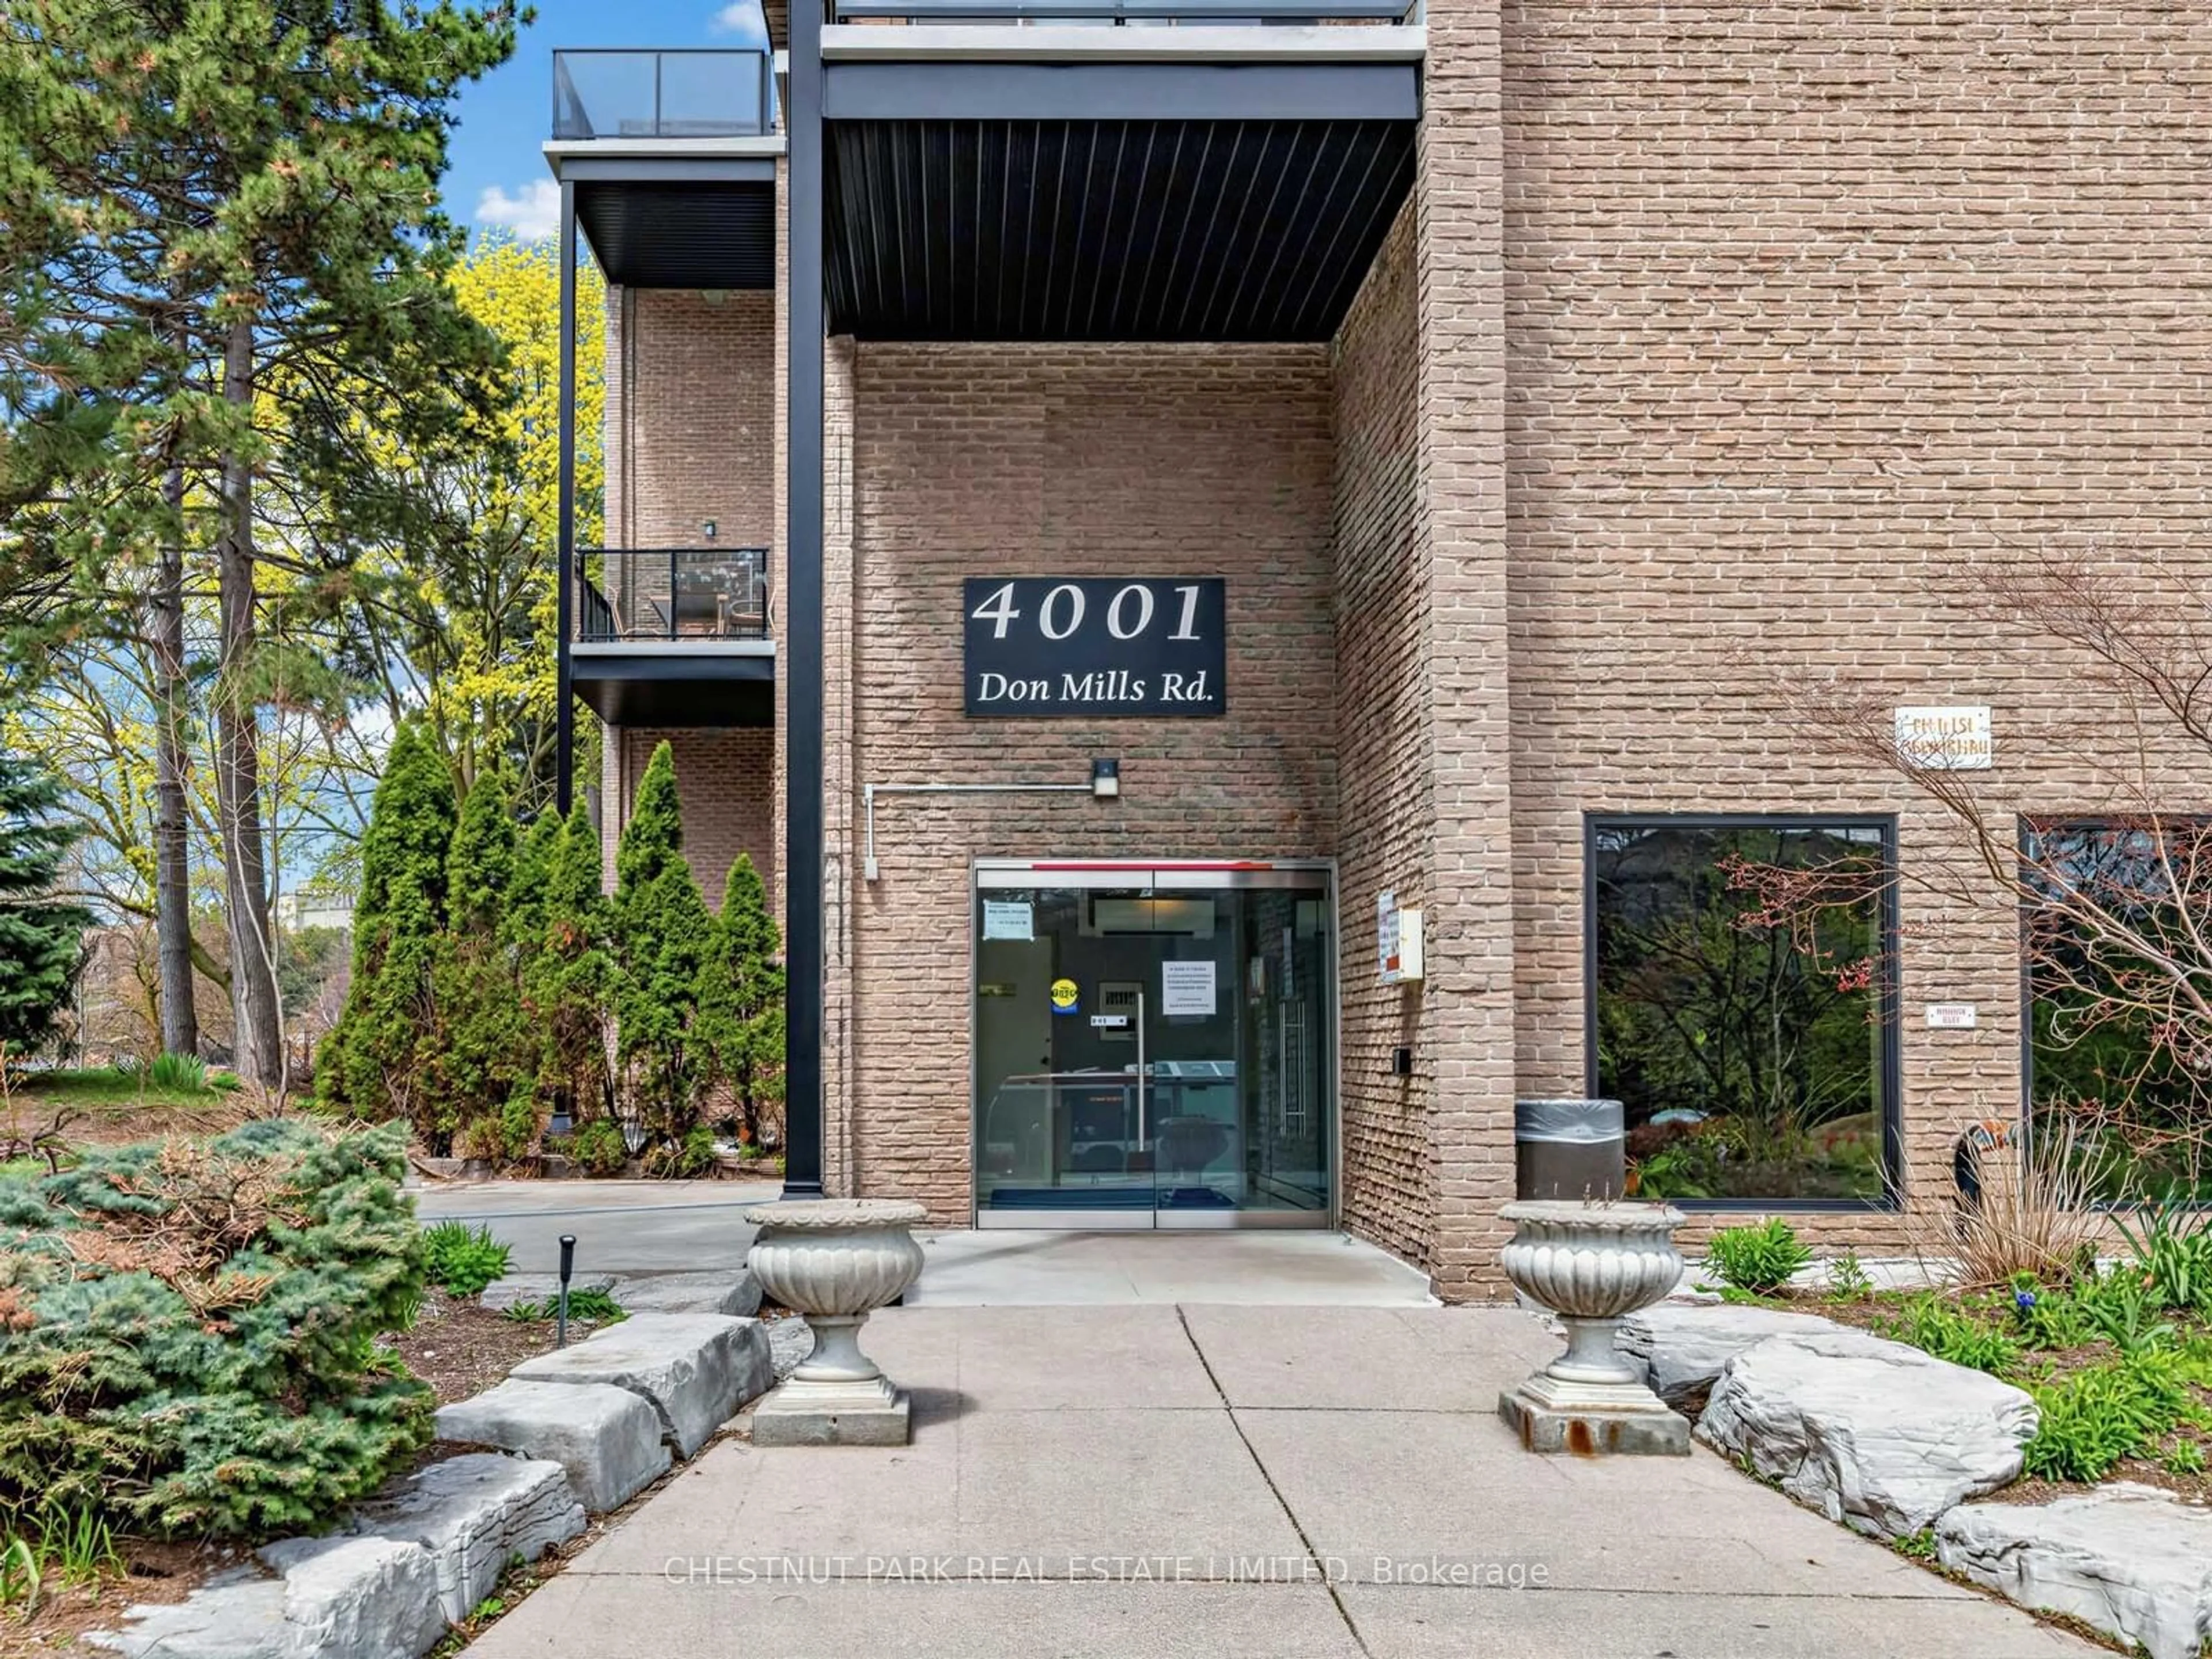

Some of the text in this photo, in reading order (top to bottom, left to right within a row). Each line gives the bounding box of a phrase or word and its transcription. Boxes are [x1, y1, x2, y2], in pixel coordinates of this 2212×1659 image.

[971, 582, 1200, 640] 4001
[977, 670, 1213, 702] Don Mills Rd.
